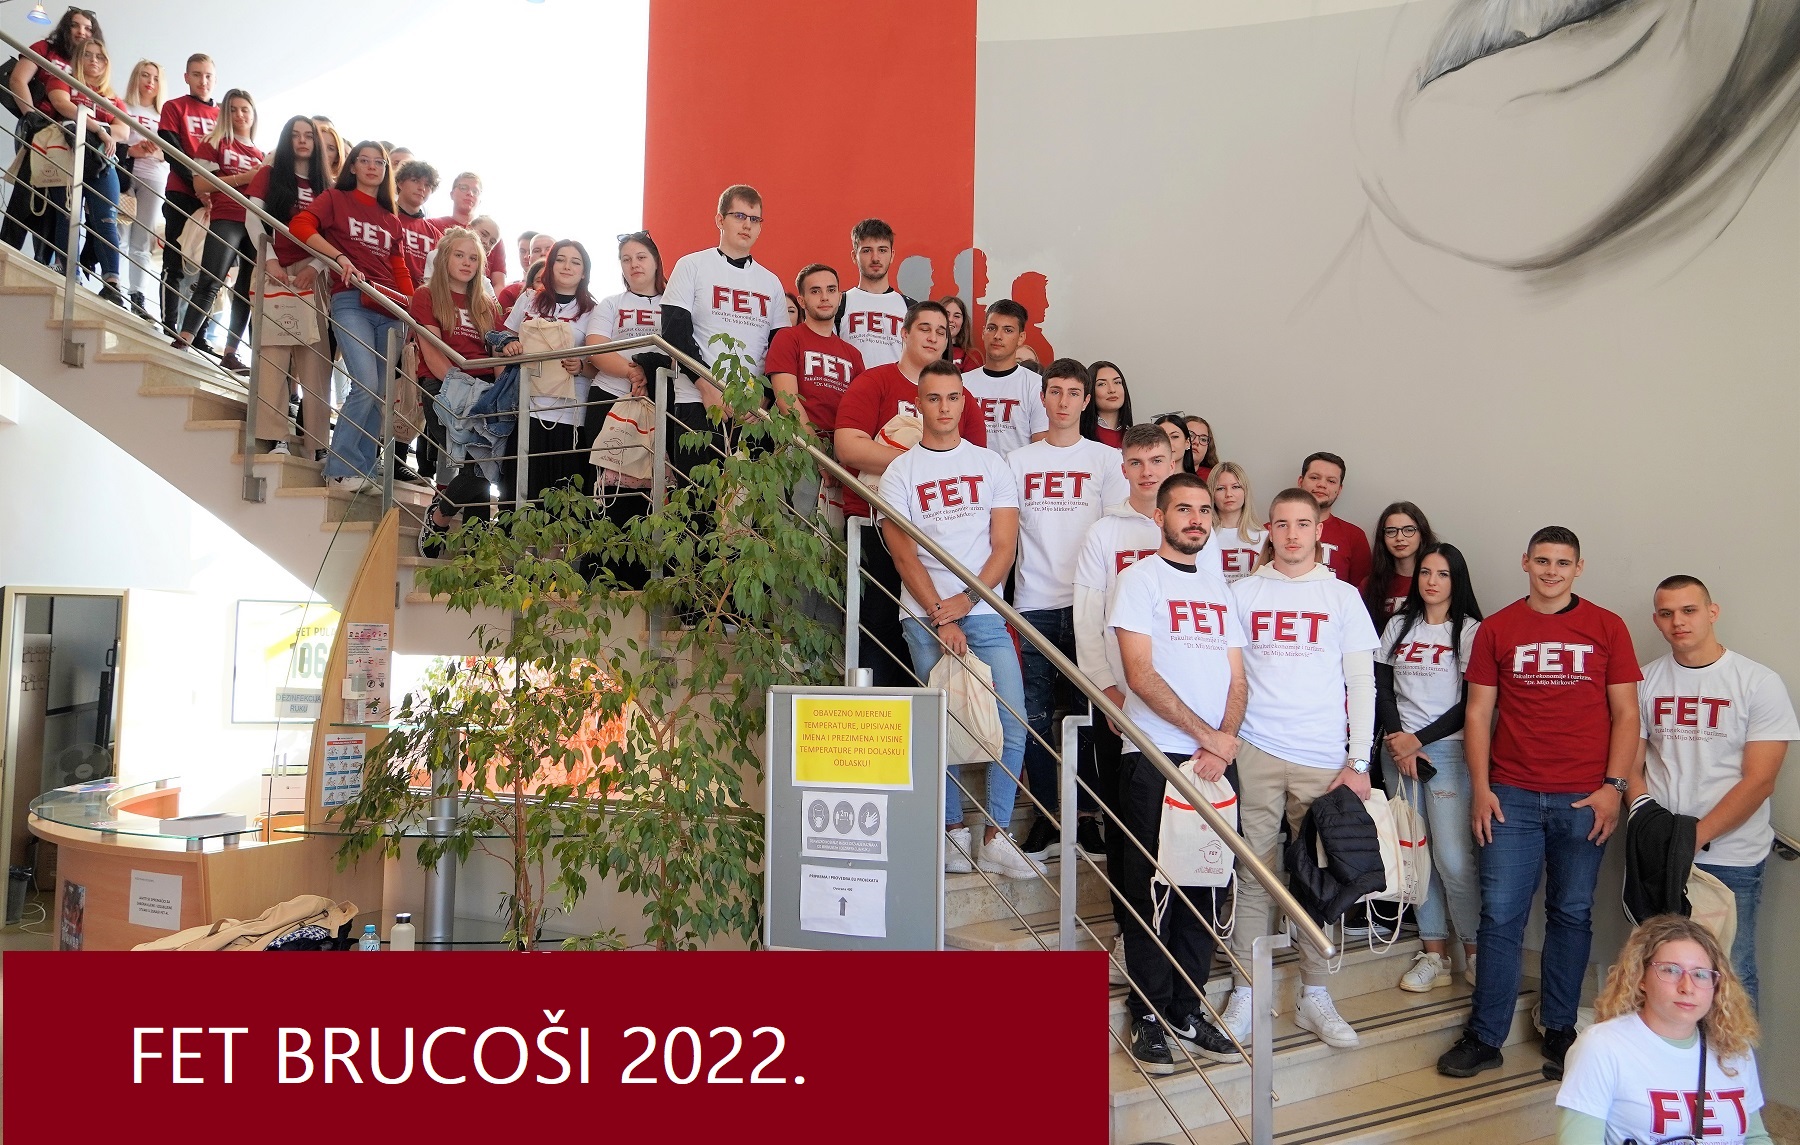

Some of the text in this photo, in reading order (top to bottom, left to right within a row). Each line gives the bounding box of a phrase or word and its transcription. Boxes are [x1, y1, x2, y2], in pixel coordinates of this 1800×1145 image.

[187, 116, 217, 134] FE
[348, 216, 392, 249] FET
[712, 285, 771, 318] FET
[849, 311, 904, 337] FET
[804, 350, 853, 383] FET
[975, 397, 1020, 423] ET
[915, 475, 984, 513] FET
[1024, 471, 1092, 500] FET
[1221, 548, 1259, 571] ET
[1167, 600, 1228, 636] FET
[1250, 610, 1329, 644] FET
[1394, 641, 1454, 664] FET
[1513, 642, 1593, 673] FET
[804, 721, 902, 731] TEMPERATURE, UPISIVANJE
[813, 709, 892, 718] OBAVEZNO MJERENJE
[1654, 696, 1731, 729] FET
[800, 746, 852, 754] TEMPERATURE
[802, 733, 826, 741] IMENA
[832, 734, 874, 742] PREZIMENA
[880, 735, 903, 743] VISINE
[1647, 1088, 1747, 1136] FET
